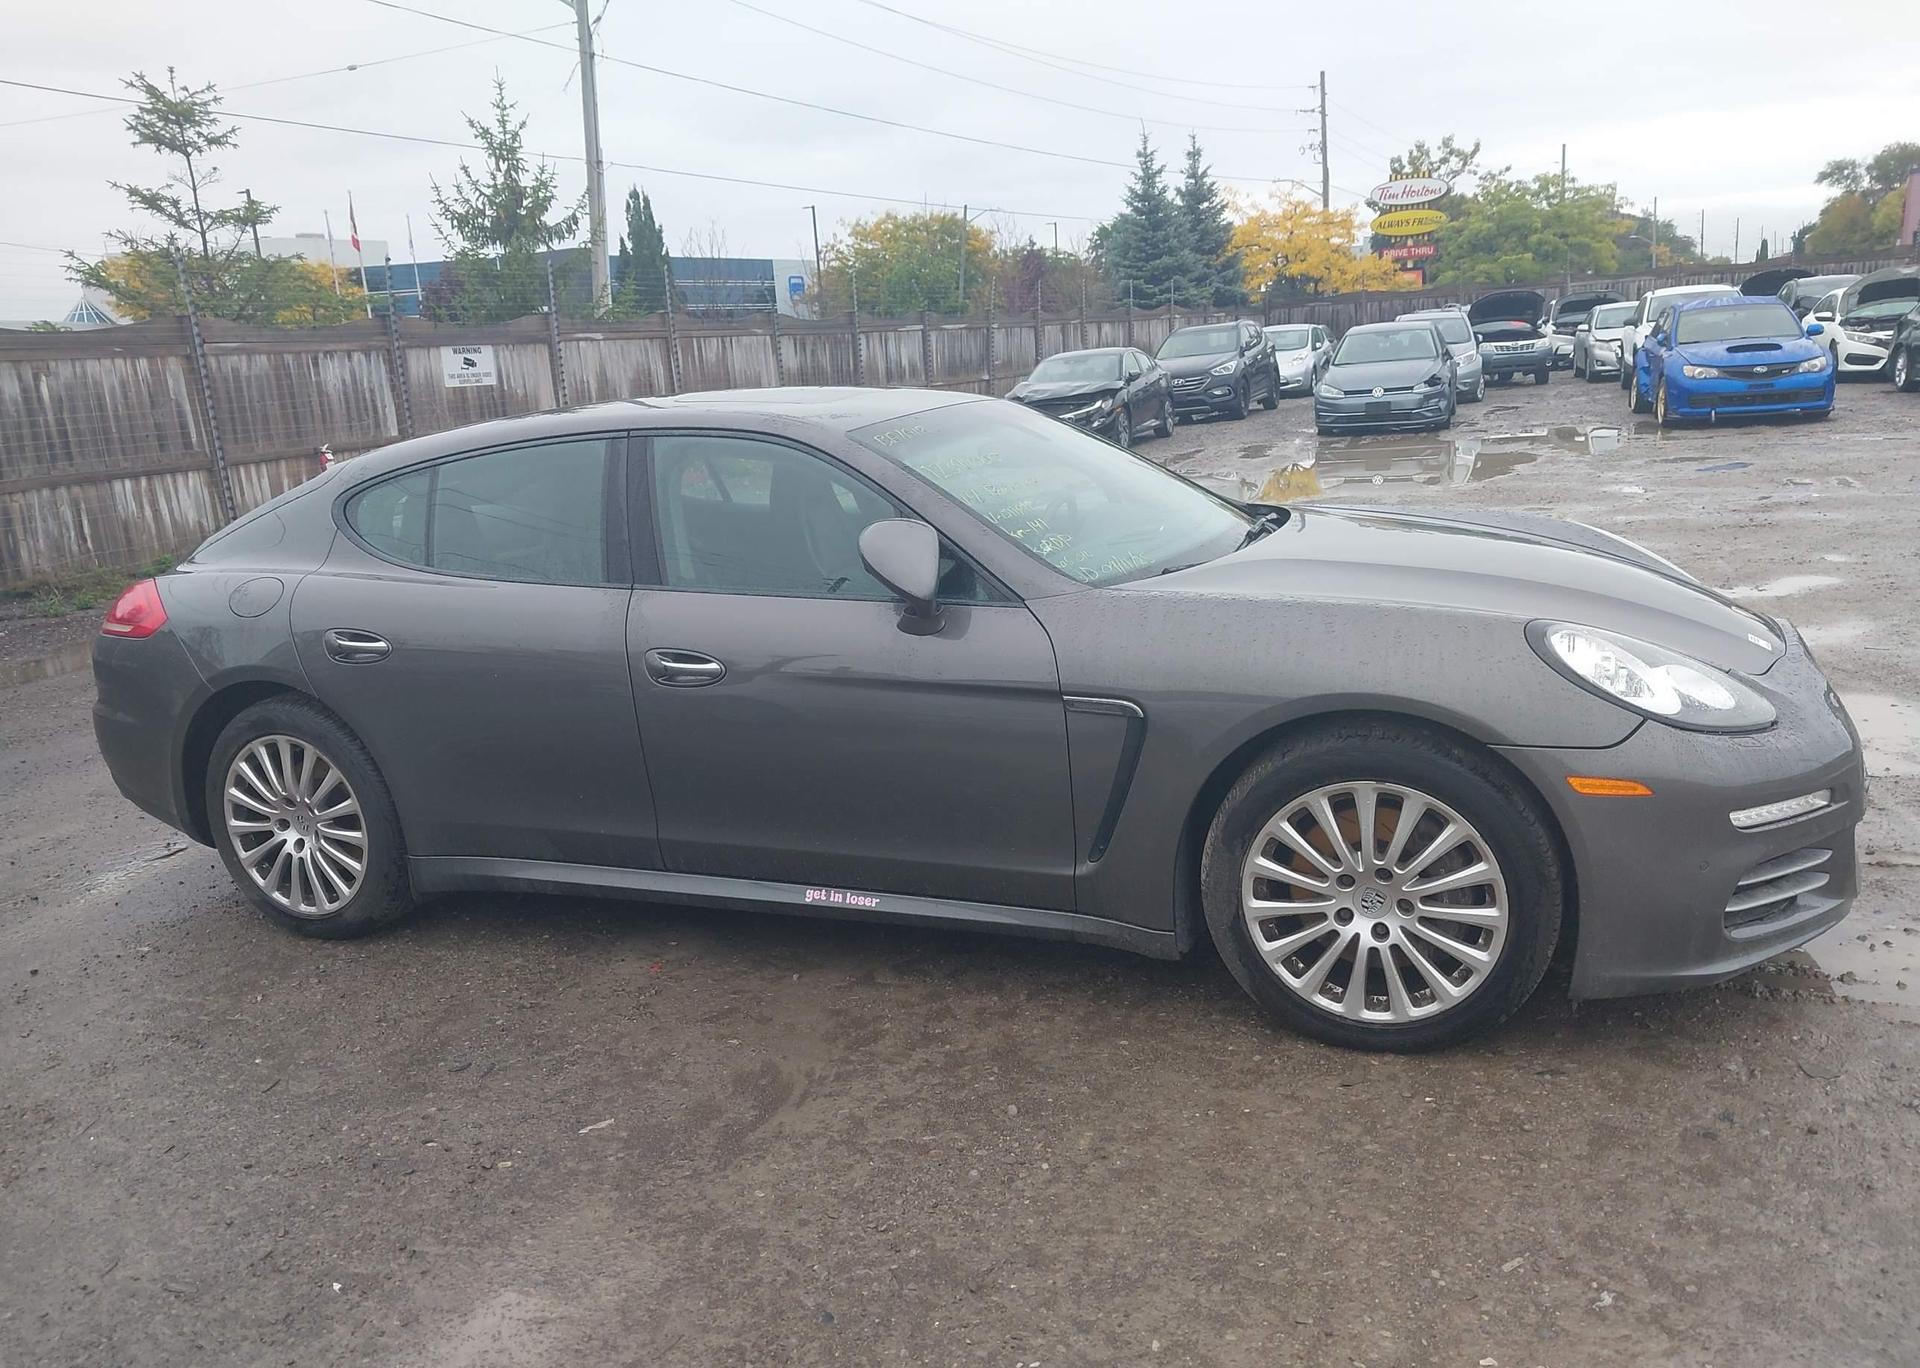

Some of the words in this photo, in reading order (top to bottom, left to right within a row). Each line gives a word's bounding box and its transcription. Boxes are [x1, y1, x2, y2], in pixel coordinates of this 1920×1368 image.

[1378, 186, 1400, 201] Tim
[1401, 184, 1442, 199] Hortons
[1376, 218, 1411, 230] ALWAYS
[1383, 248, 1409, 257] DRIVE
[1410, 246, 1435, 255] THRU
[452, 346, 482, 355] WARNING
[805, 889, 827, 902] get
[829, 890, 843, 903] in
[845, 892, 880, 907] loser
